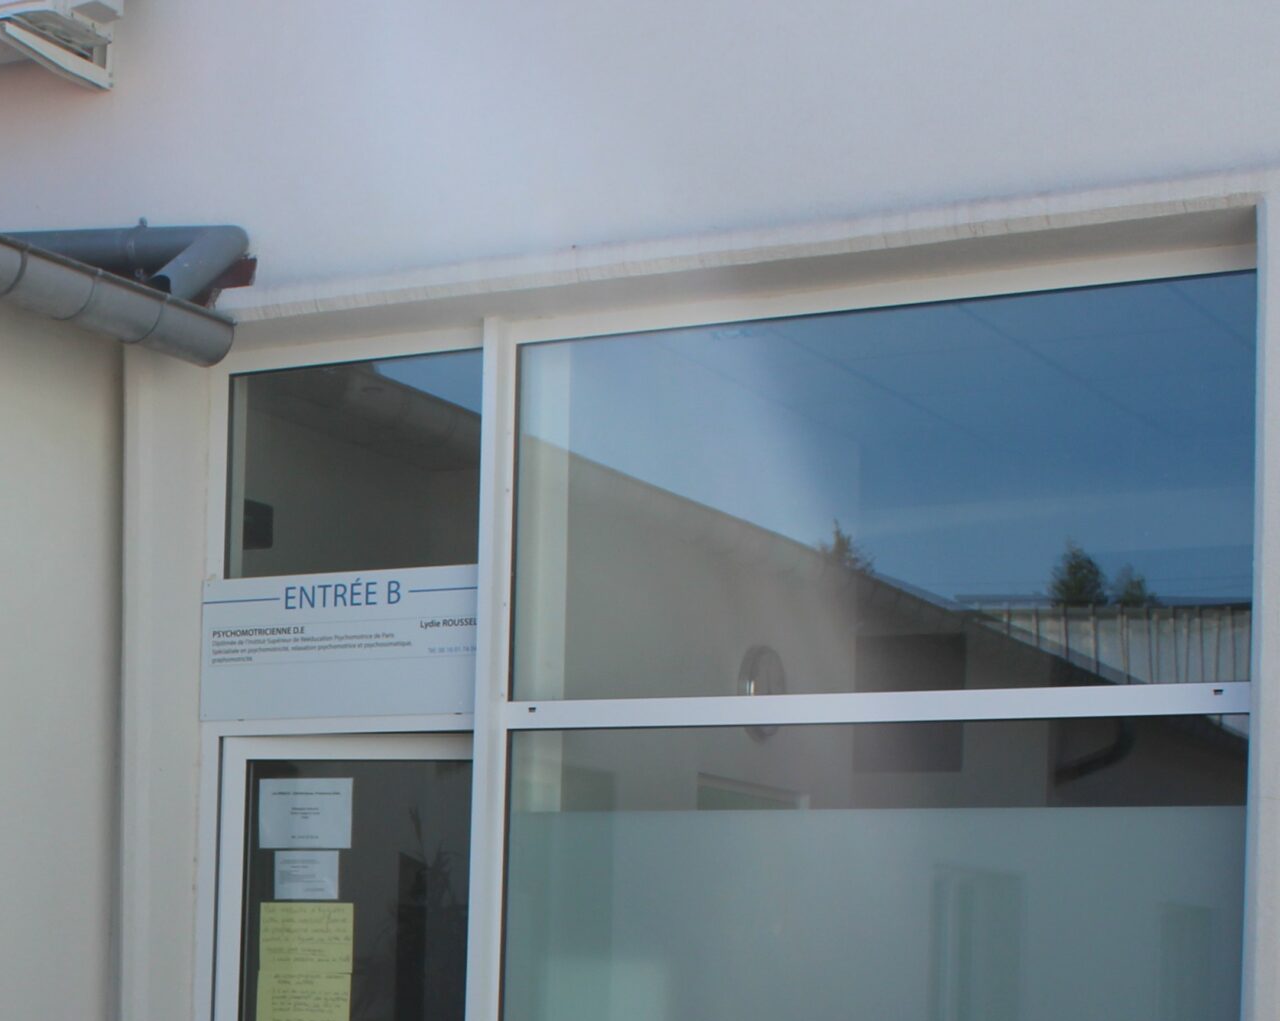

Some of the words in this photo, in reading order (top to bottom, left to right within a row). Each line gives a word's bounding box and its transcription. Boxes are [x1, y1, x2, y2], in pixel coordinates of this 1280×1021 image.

[284, 578, 378, 610] ENTRÉE
[386, 580, 402, 605] B
[419, 620, 441, 629] Lydie
[212, 626, 291, 638] PSYCHOMOTRICIENNE
